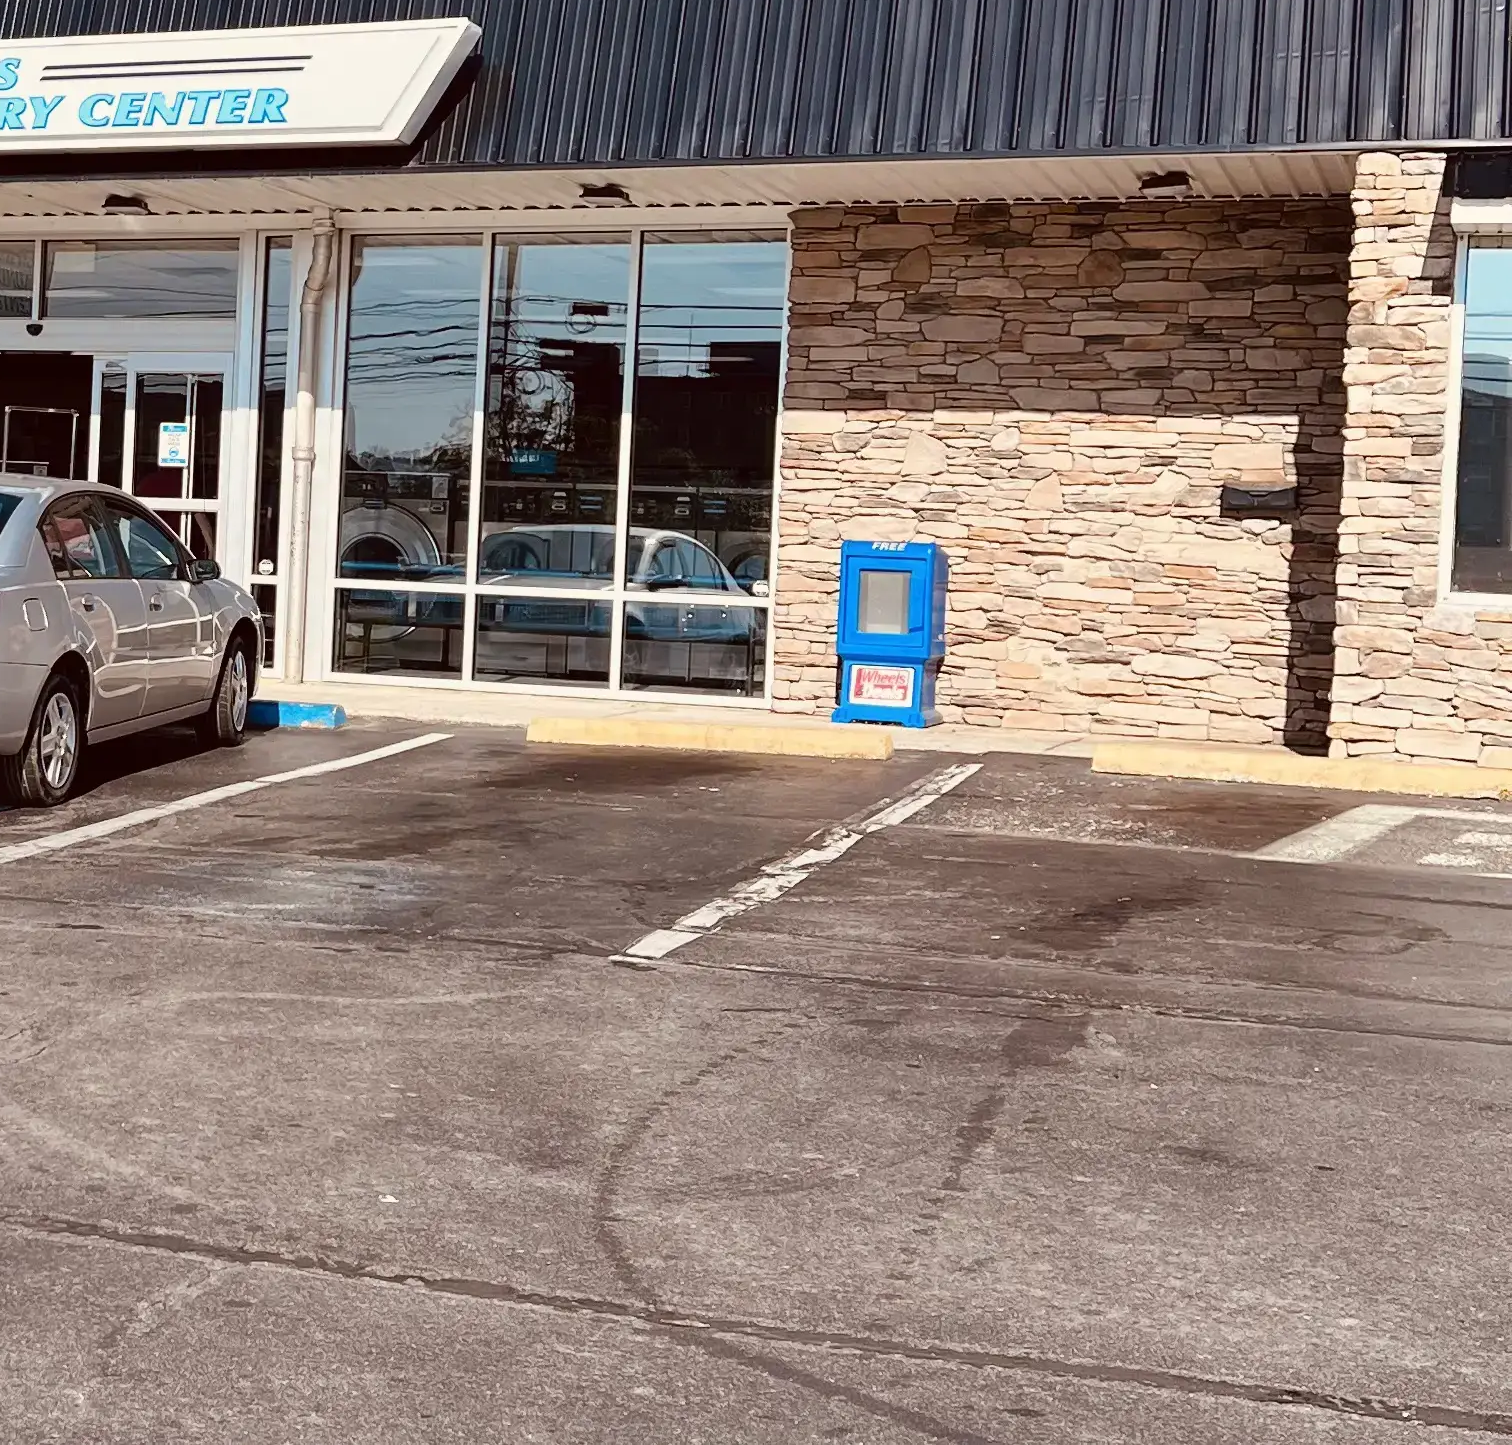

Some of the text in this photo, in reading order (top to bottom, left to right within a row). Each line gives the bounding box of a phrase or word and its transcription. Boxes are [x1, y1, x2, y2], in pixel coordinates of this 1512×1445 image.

[79, 87, 289, 128] CENTER
[872, 541, 907, 551] FREE
[862, 669, 906, 685] Wheels
